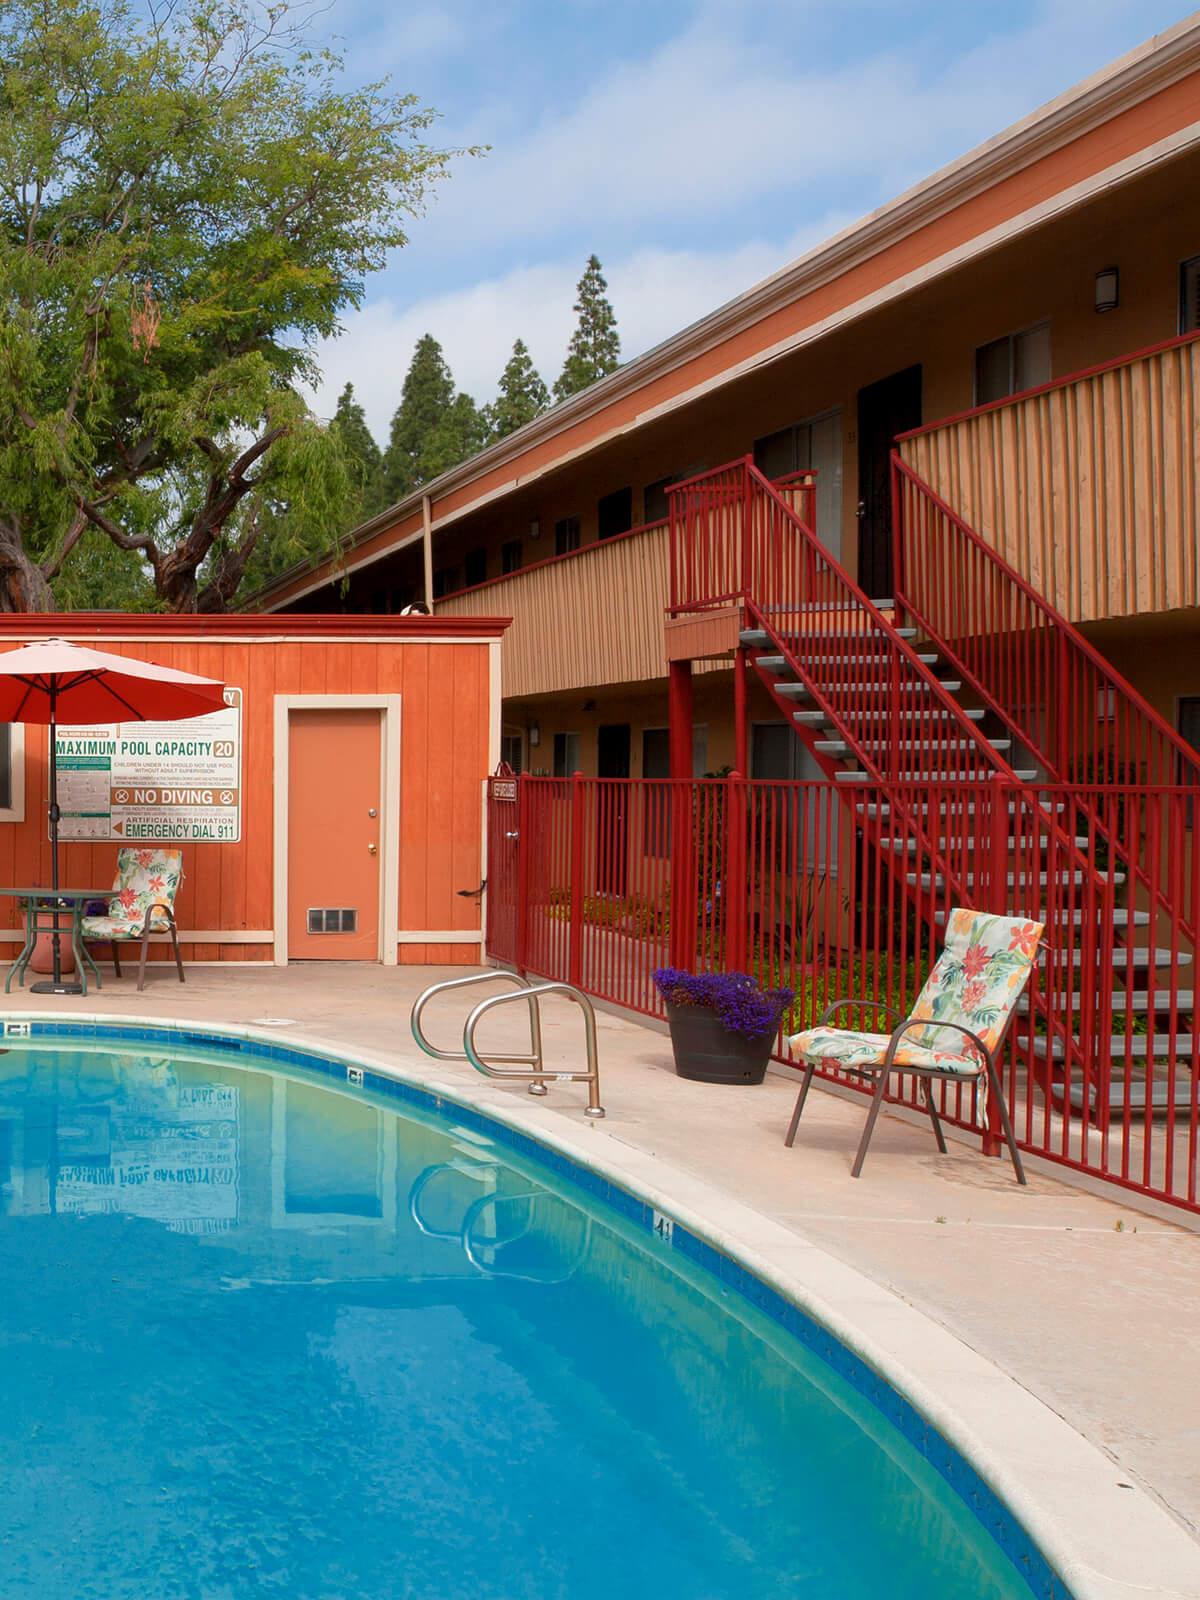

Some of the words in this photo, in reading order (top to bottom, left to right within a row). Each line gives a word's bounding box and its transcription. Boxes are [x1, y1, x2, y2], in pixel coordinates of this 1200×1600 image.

[56, 741, 116, 755] MAXIMUM
[122, 741, 151, 756] POOL
[155, 741, 212, 756] CAPACITY
[215, 742, 233, 757] 20
[134, 789, 157, 804] NO
[161, 789, 213, 804] DIVING
[125, 823, 189, 837] EMERGENCY
[192, 824, 215, 838] DIAL
[217, 824, 233, 838] 911
